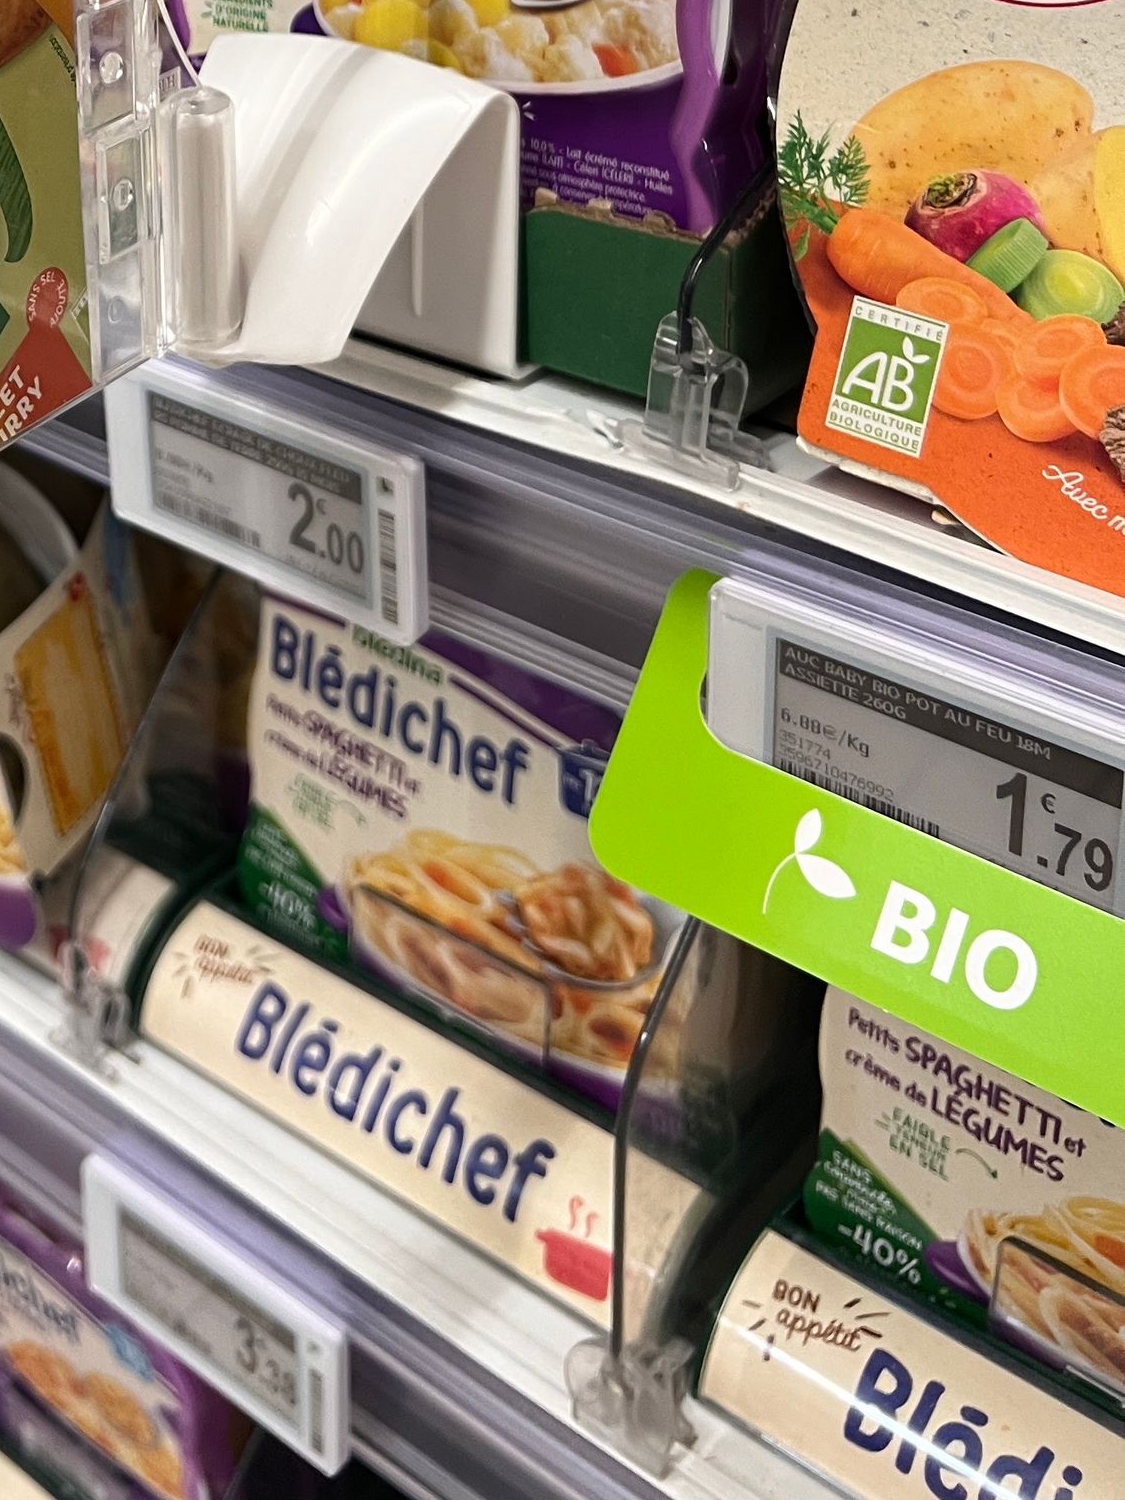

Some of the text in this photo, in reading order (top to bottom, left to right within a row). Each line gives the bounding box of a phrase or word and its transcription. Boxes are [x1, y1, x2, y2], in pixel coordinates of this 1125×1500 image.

[855, 305, 945, 343] CERTIFIÉ
[841, 350, 917, 412] AB
[829, 411, 920, 451] BIOLOGIQUE
[831, 397, 923, 437] AGRICULTURE
[1041, 464, 1109, 520] Avec
[270, 614, 532, 806] Blédichef
[785, 663, 907, 721] ASSIETTE 260G
[785, 646, 1052, 761] AUC BABY BIO POT AU FEU 18M
[870, 879, 1037, 1011] BIO
[234, 980, 556, 1224] Blédichef
[905, 1035, 1063, 1146] SPAGHETTI
[930, 1083, 1066, 1183] LÉGUMES
[773, 1278, 821, 1311] BON
[777, 1306, 864, 1353] appétit
